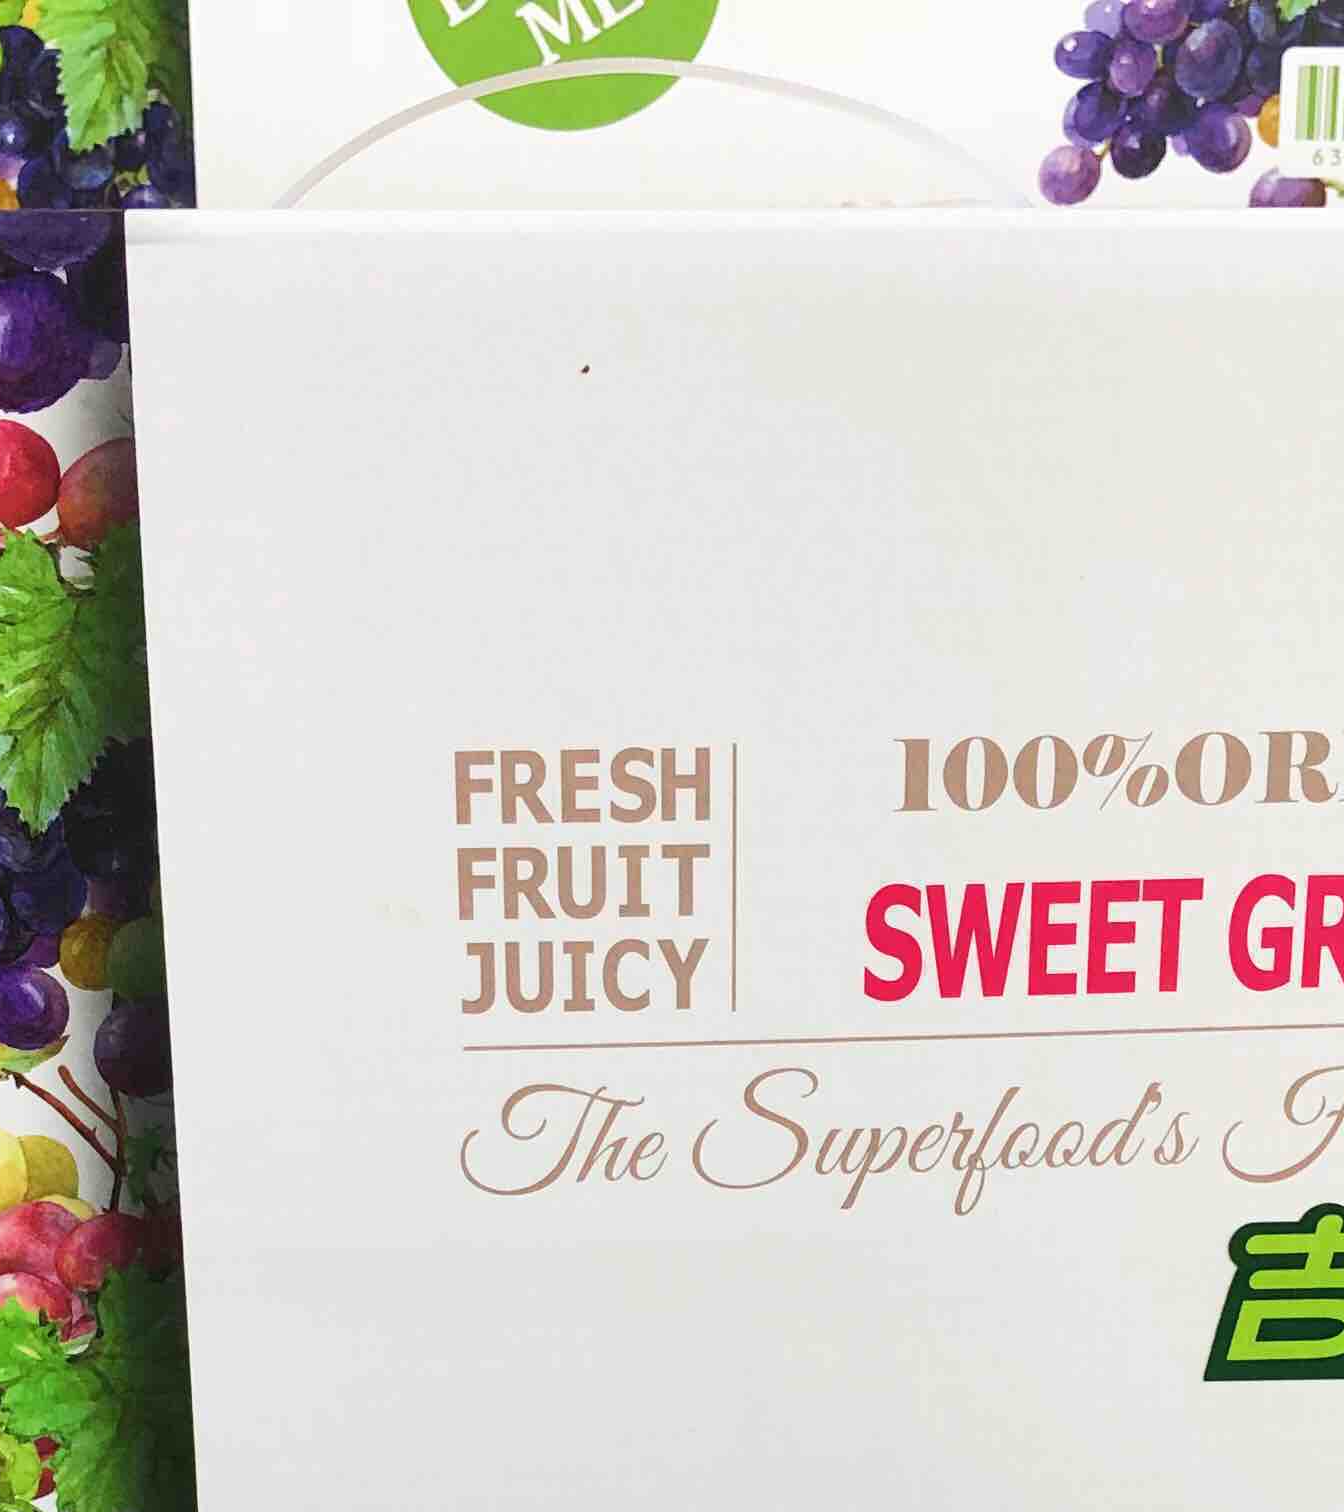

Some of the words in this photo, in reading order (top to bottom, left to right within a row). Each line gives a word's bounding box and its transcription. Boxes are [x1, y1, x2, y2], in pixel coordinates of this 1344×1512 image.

[1312, 149, 1324, 167] 6
[454, 747, 710, 824] FRESH
[456, 844, 710, 921] FRUIT
[461, 938, 710, 1015] JUICY
[862, 877, 1204, 1001] SWEET
[460, 1083, 667, 1196] The
[693, 1067, 1198, 1216] Superfood's
